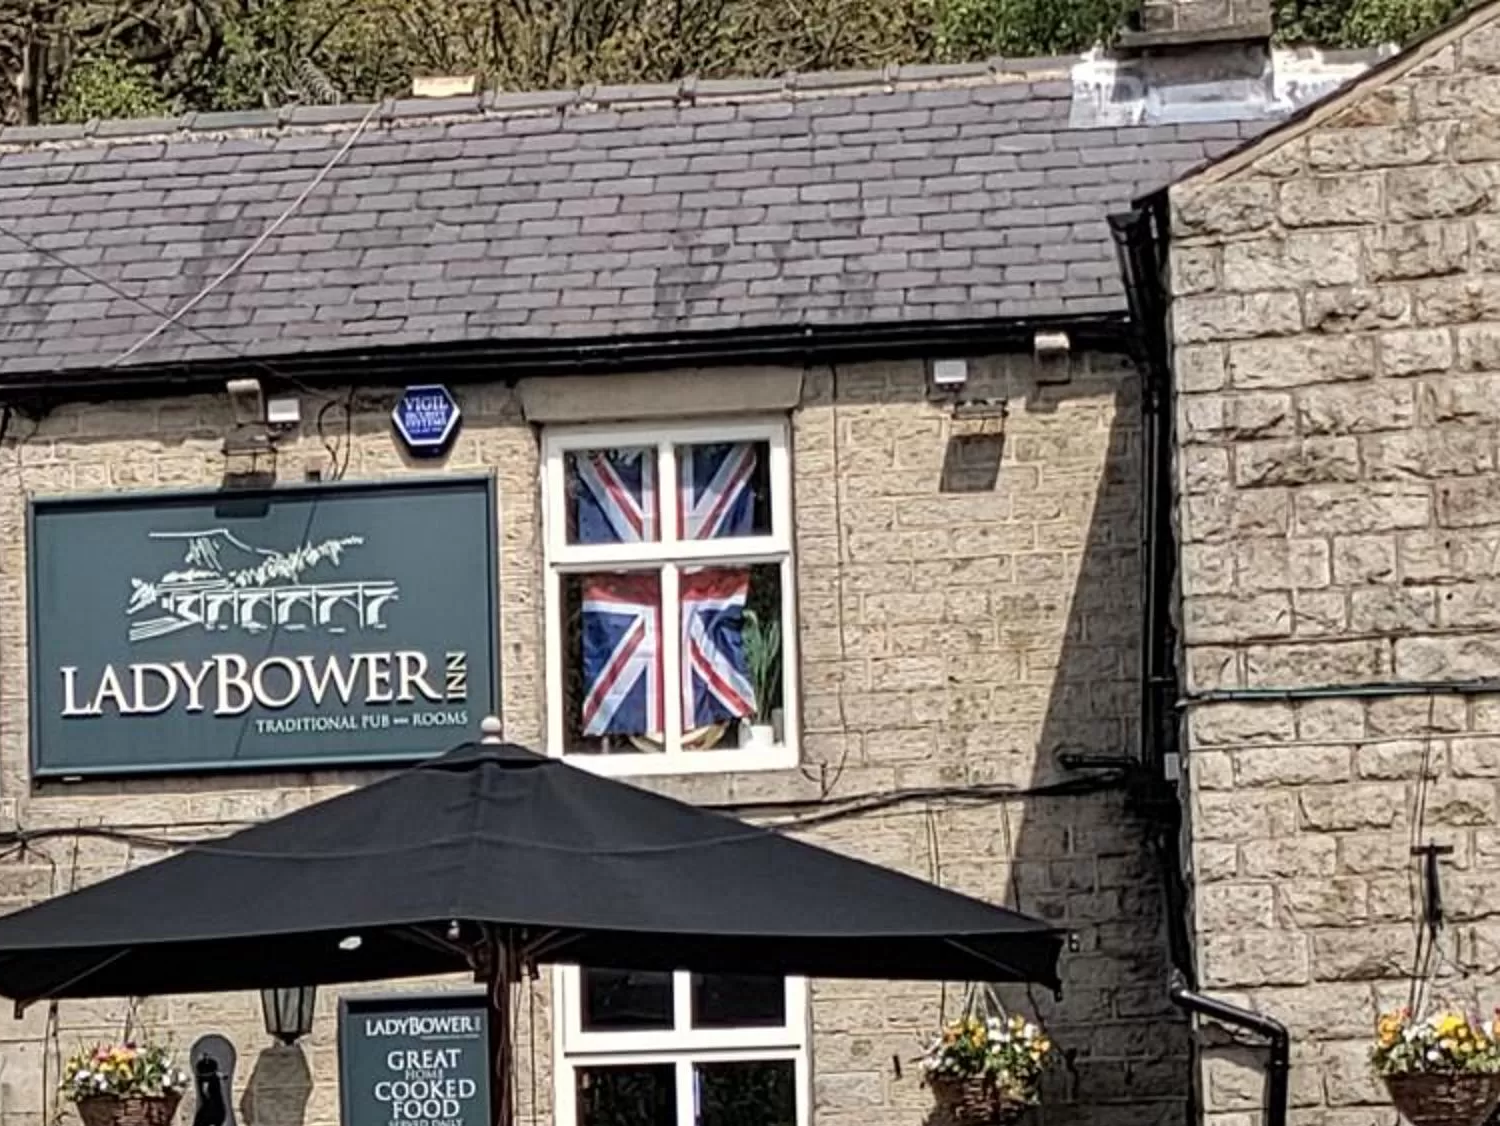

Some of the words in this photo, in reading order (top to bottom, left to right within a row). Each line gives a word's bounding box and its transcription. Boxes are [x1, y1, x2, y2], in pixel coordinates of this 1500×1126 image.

[61, 651, 443, 718] LADYBOWER
[446, 651, 468, 698] INN
[256, 715, 358, 733] TRADITIONAL
[362, 713, 390, 729] PUB
[413, 711, 468, 726] ROOMS
[366, 1016, 472, 1036] LADYBOWER
[387, 1048, 461, 1071] GREAT
[405, 1068, 443, 1080] HOME
[375, 1079, 476, 1101] COOKED
[393, 1100, 460, 1119] FOOD
